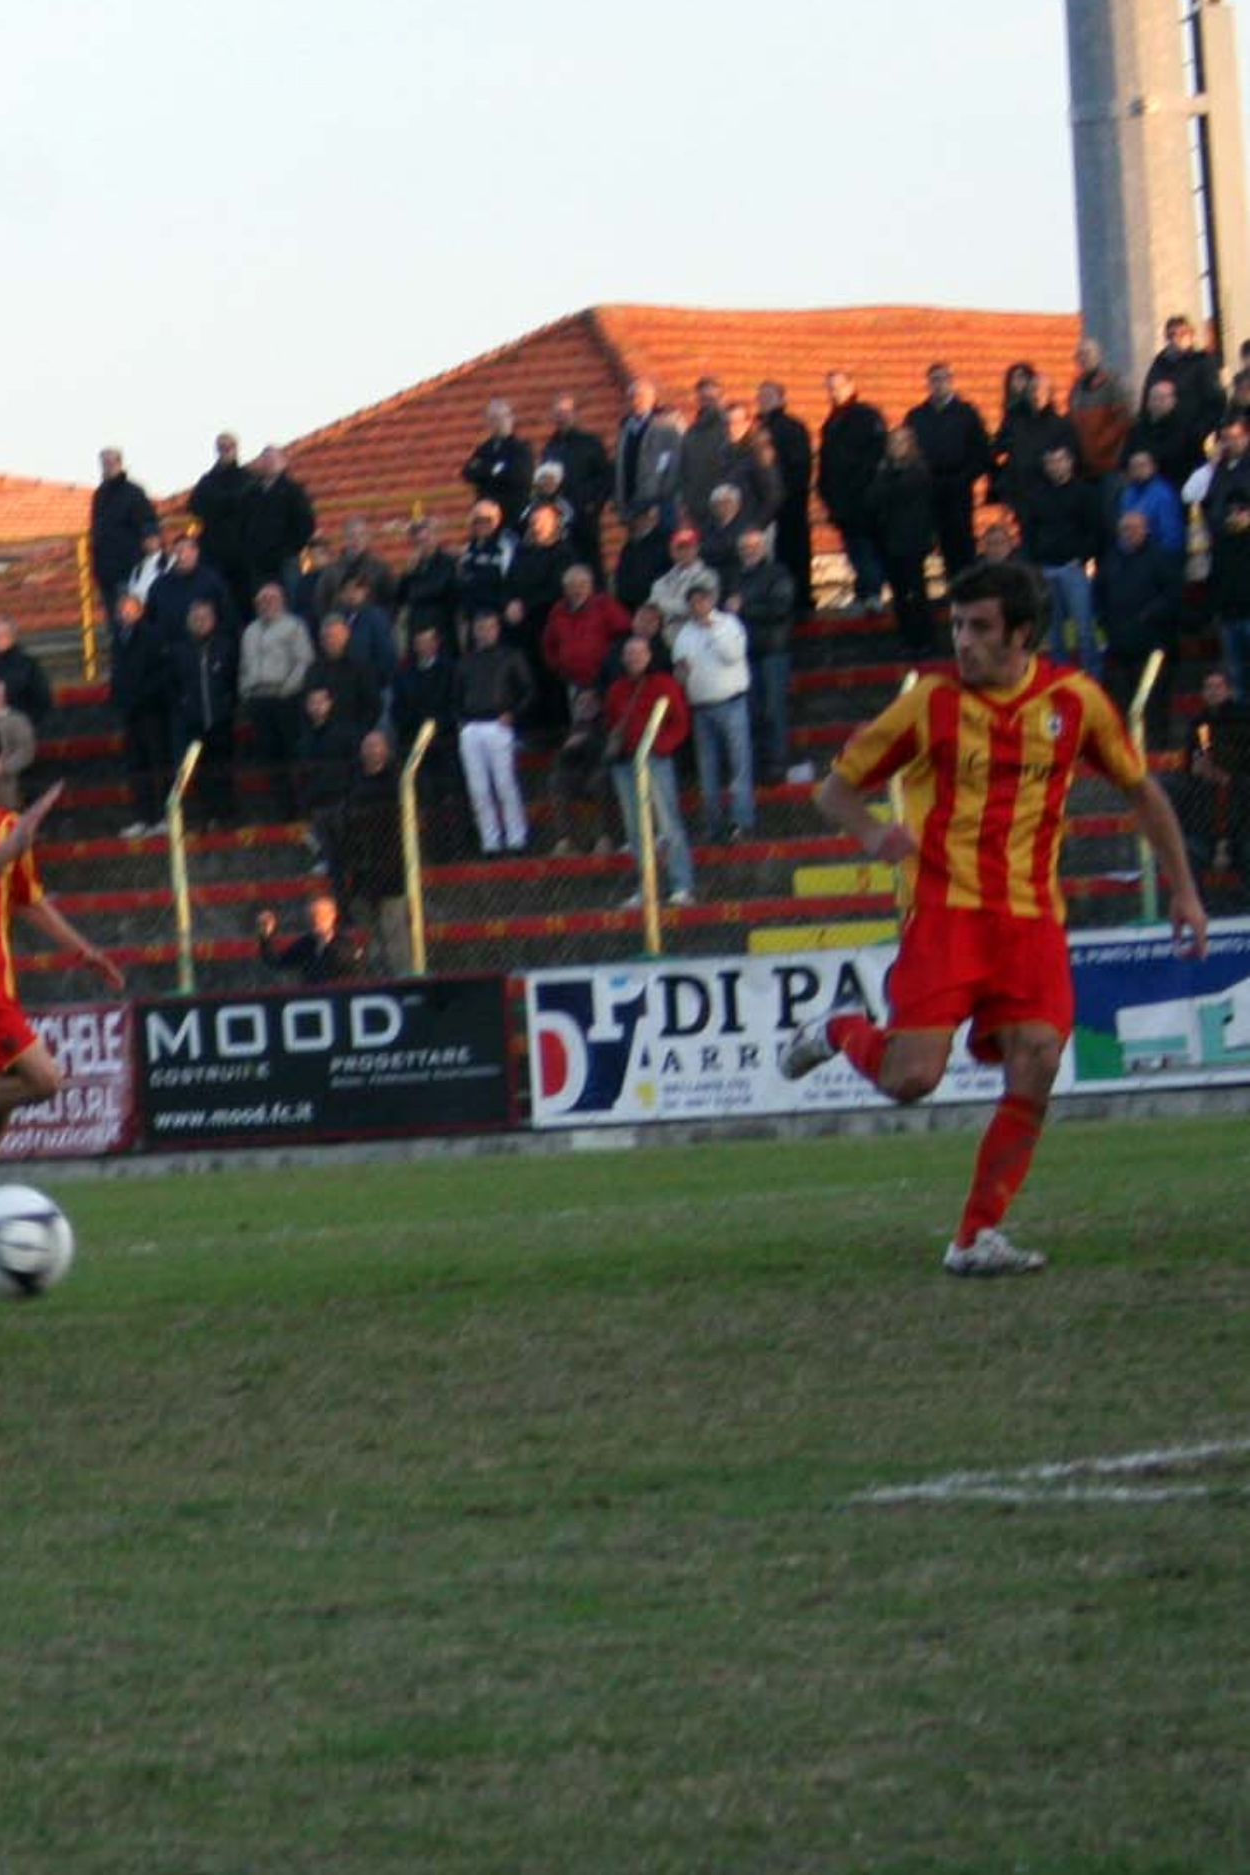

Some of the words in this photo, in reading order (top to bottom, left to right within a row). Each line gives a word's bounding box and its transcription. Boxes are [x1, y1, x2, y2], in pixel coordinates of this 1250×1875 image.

[145, 994, 404, 1064] MOOD
[656, 969, 746, 1040] DI
[771, 959, 896, 1030] PA
